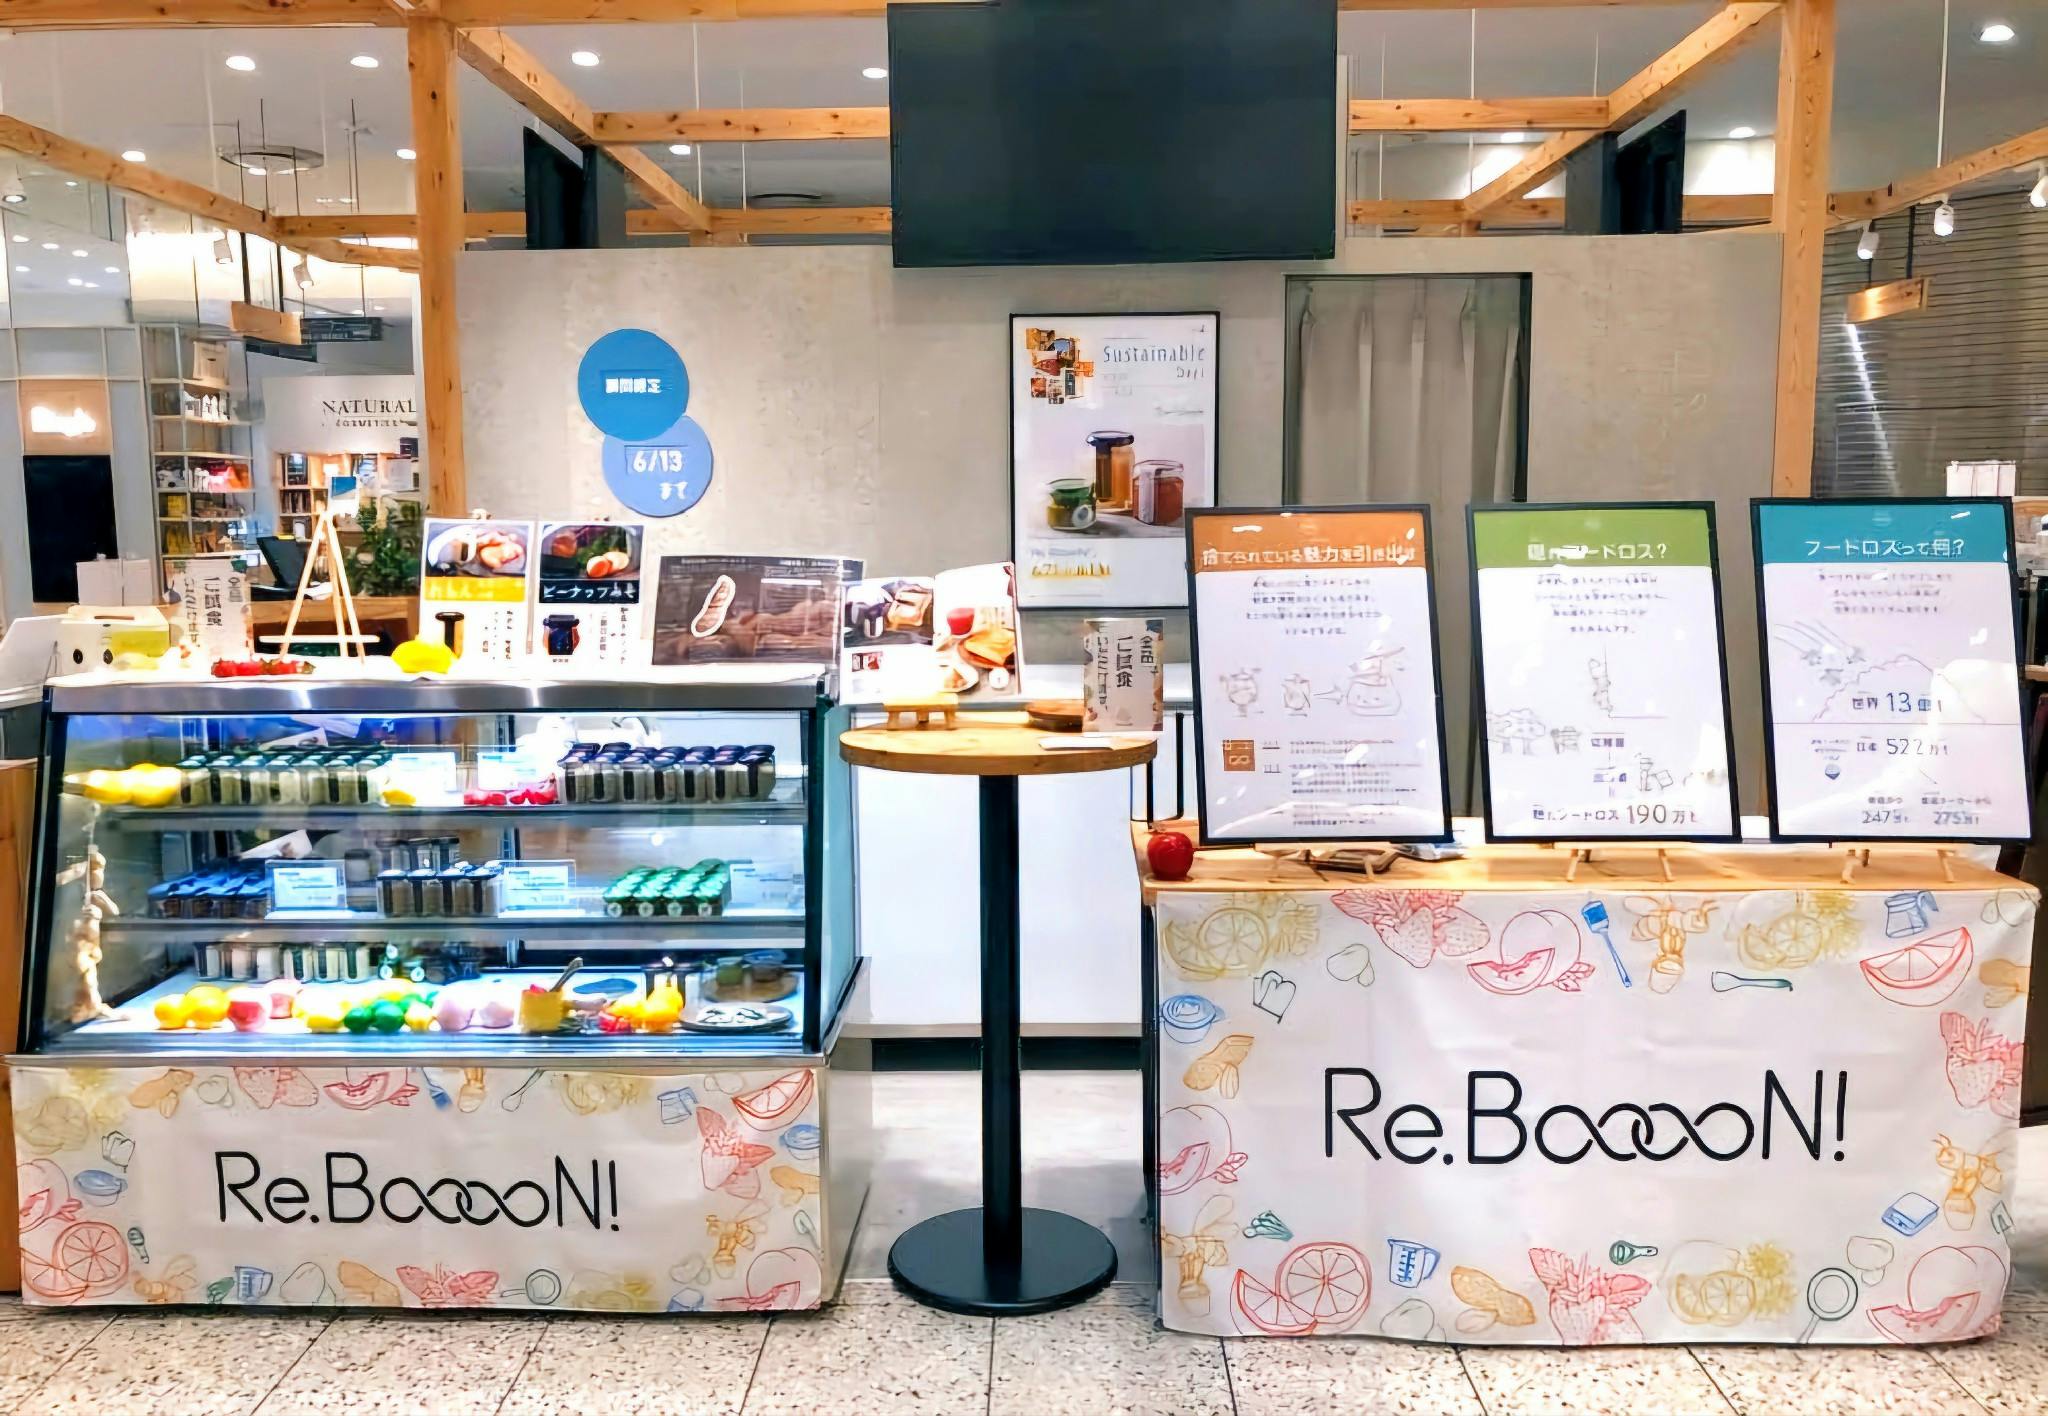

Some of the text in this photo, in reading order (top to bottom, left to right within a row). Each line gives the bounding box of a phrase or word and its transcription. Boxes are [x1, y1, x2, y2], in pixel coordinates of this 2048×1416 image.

[1103, 344, 1205, 363] Sustainable
[322, 398, 417, 415] NATURAL
[633, 450, 683, 473] 6/13
[1886, 691, 1912, 713] 13
[1886, 738, 1925, 755] 522
[1626, 804, 1667, 825] 190
